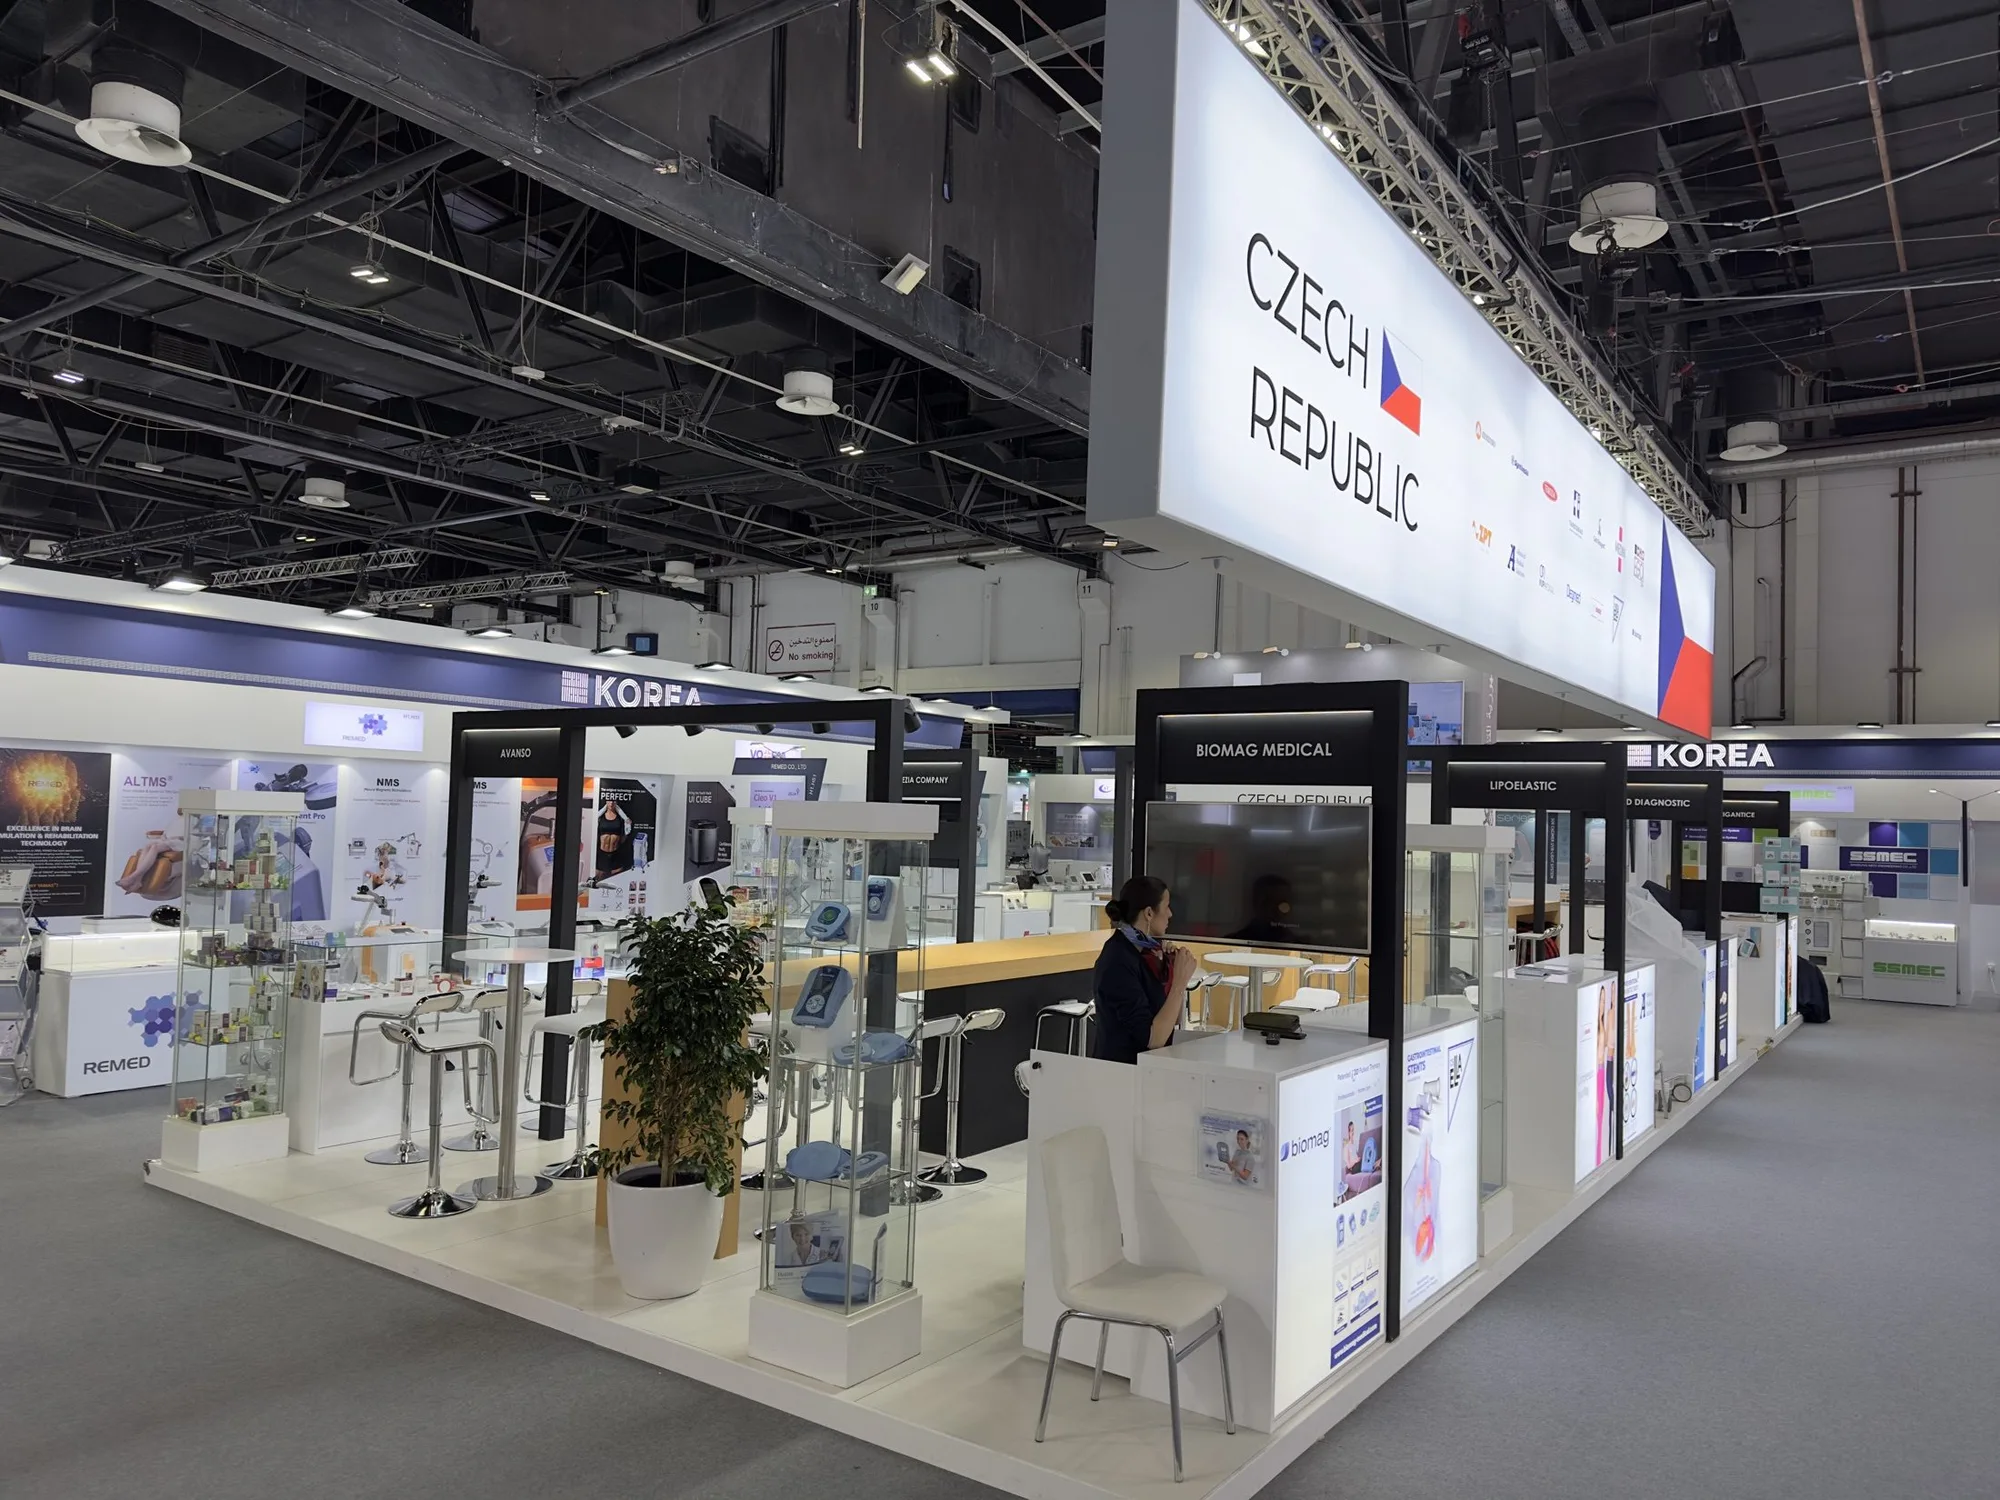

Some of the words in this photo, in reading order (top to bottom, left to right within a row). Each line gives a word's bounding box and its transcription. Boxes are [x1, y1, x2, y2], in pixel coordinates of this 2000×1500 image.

[1247, 232, 1368, 389] CZECH
[1250, 365, 1419, 532] REPUBLIC
[1082, 586, 1090, 594] 11
[871, 602, 878, 610] 10
[789, 652, 799, 660] No
[802, 651, 833, 660] smoking
[594, 675, 702, 708] KOREA
[500, 748, 531, 758] AVANSO
[1196, 744, 1258, 757] BIOMAG
[1262, 743, 1332, 756] MEDICAL
[1657, 744, 1774, 767] KOREA
[376, 778, 400, 787] NMS
[902, 776, 914, 784] EZIA
[916, 776, 948, 784] COMPANY
[1490, 781, 1557, 790] LIPOELASTIC
[601, 792, 632, 801] PERFECT
[696, 796, 712, 804] CUBE
[1634, 799, 1690, 807] DIAGNOSTIC
[1850, 851, 1917, 862] SSMEC
[1873, 962, 1945, 977] SSMEC
[83, 1056, 151, 1075] REMED
[1408, 1060, 1426, 1075] STENTS
[1292, 1130, 1329, 1157] biomag
